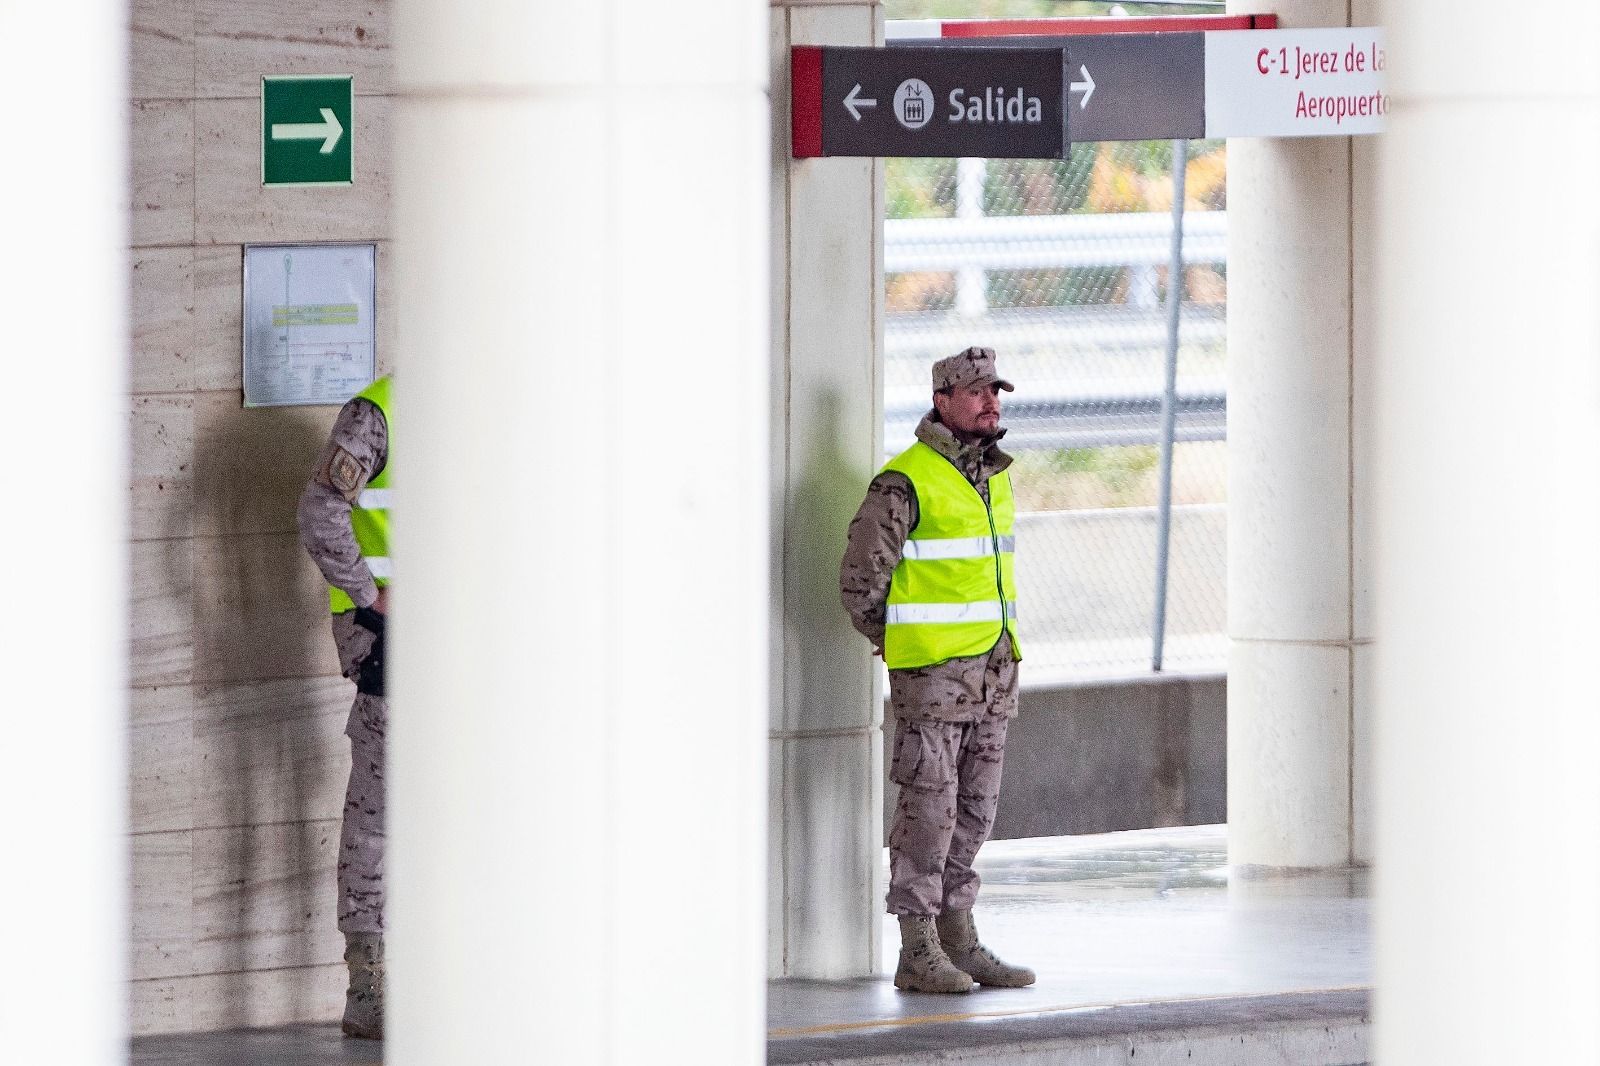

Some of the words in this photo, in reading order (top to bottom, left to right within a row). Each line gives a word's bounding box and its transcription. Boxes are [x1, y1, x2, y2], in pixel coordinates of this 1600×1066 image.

[1256, 47, 1289, 75] C-1
[1295, 46, 1338, 79] Jerez
[1344, 42, 1365, 72] de
[948, 87, 1043, 123] Salida
